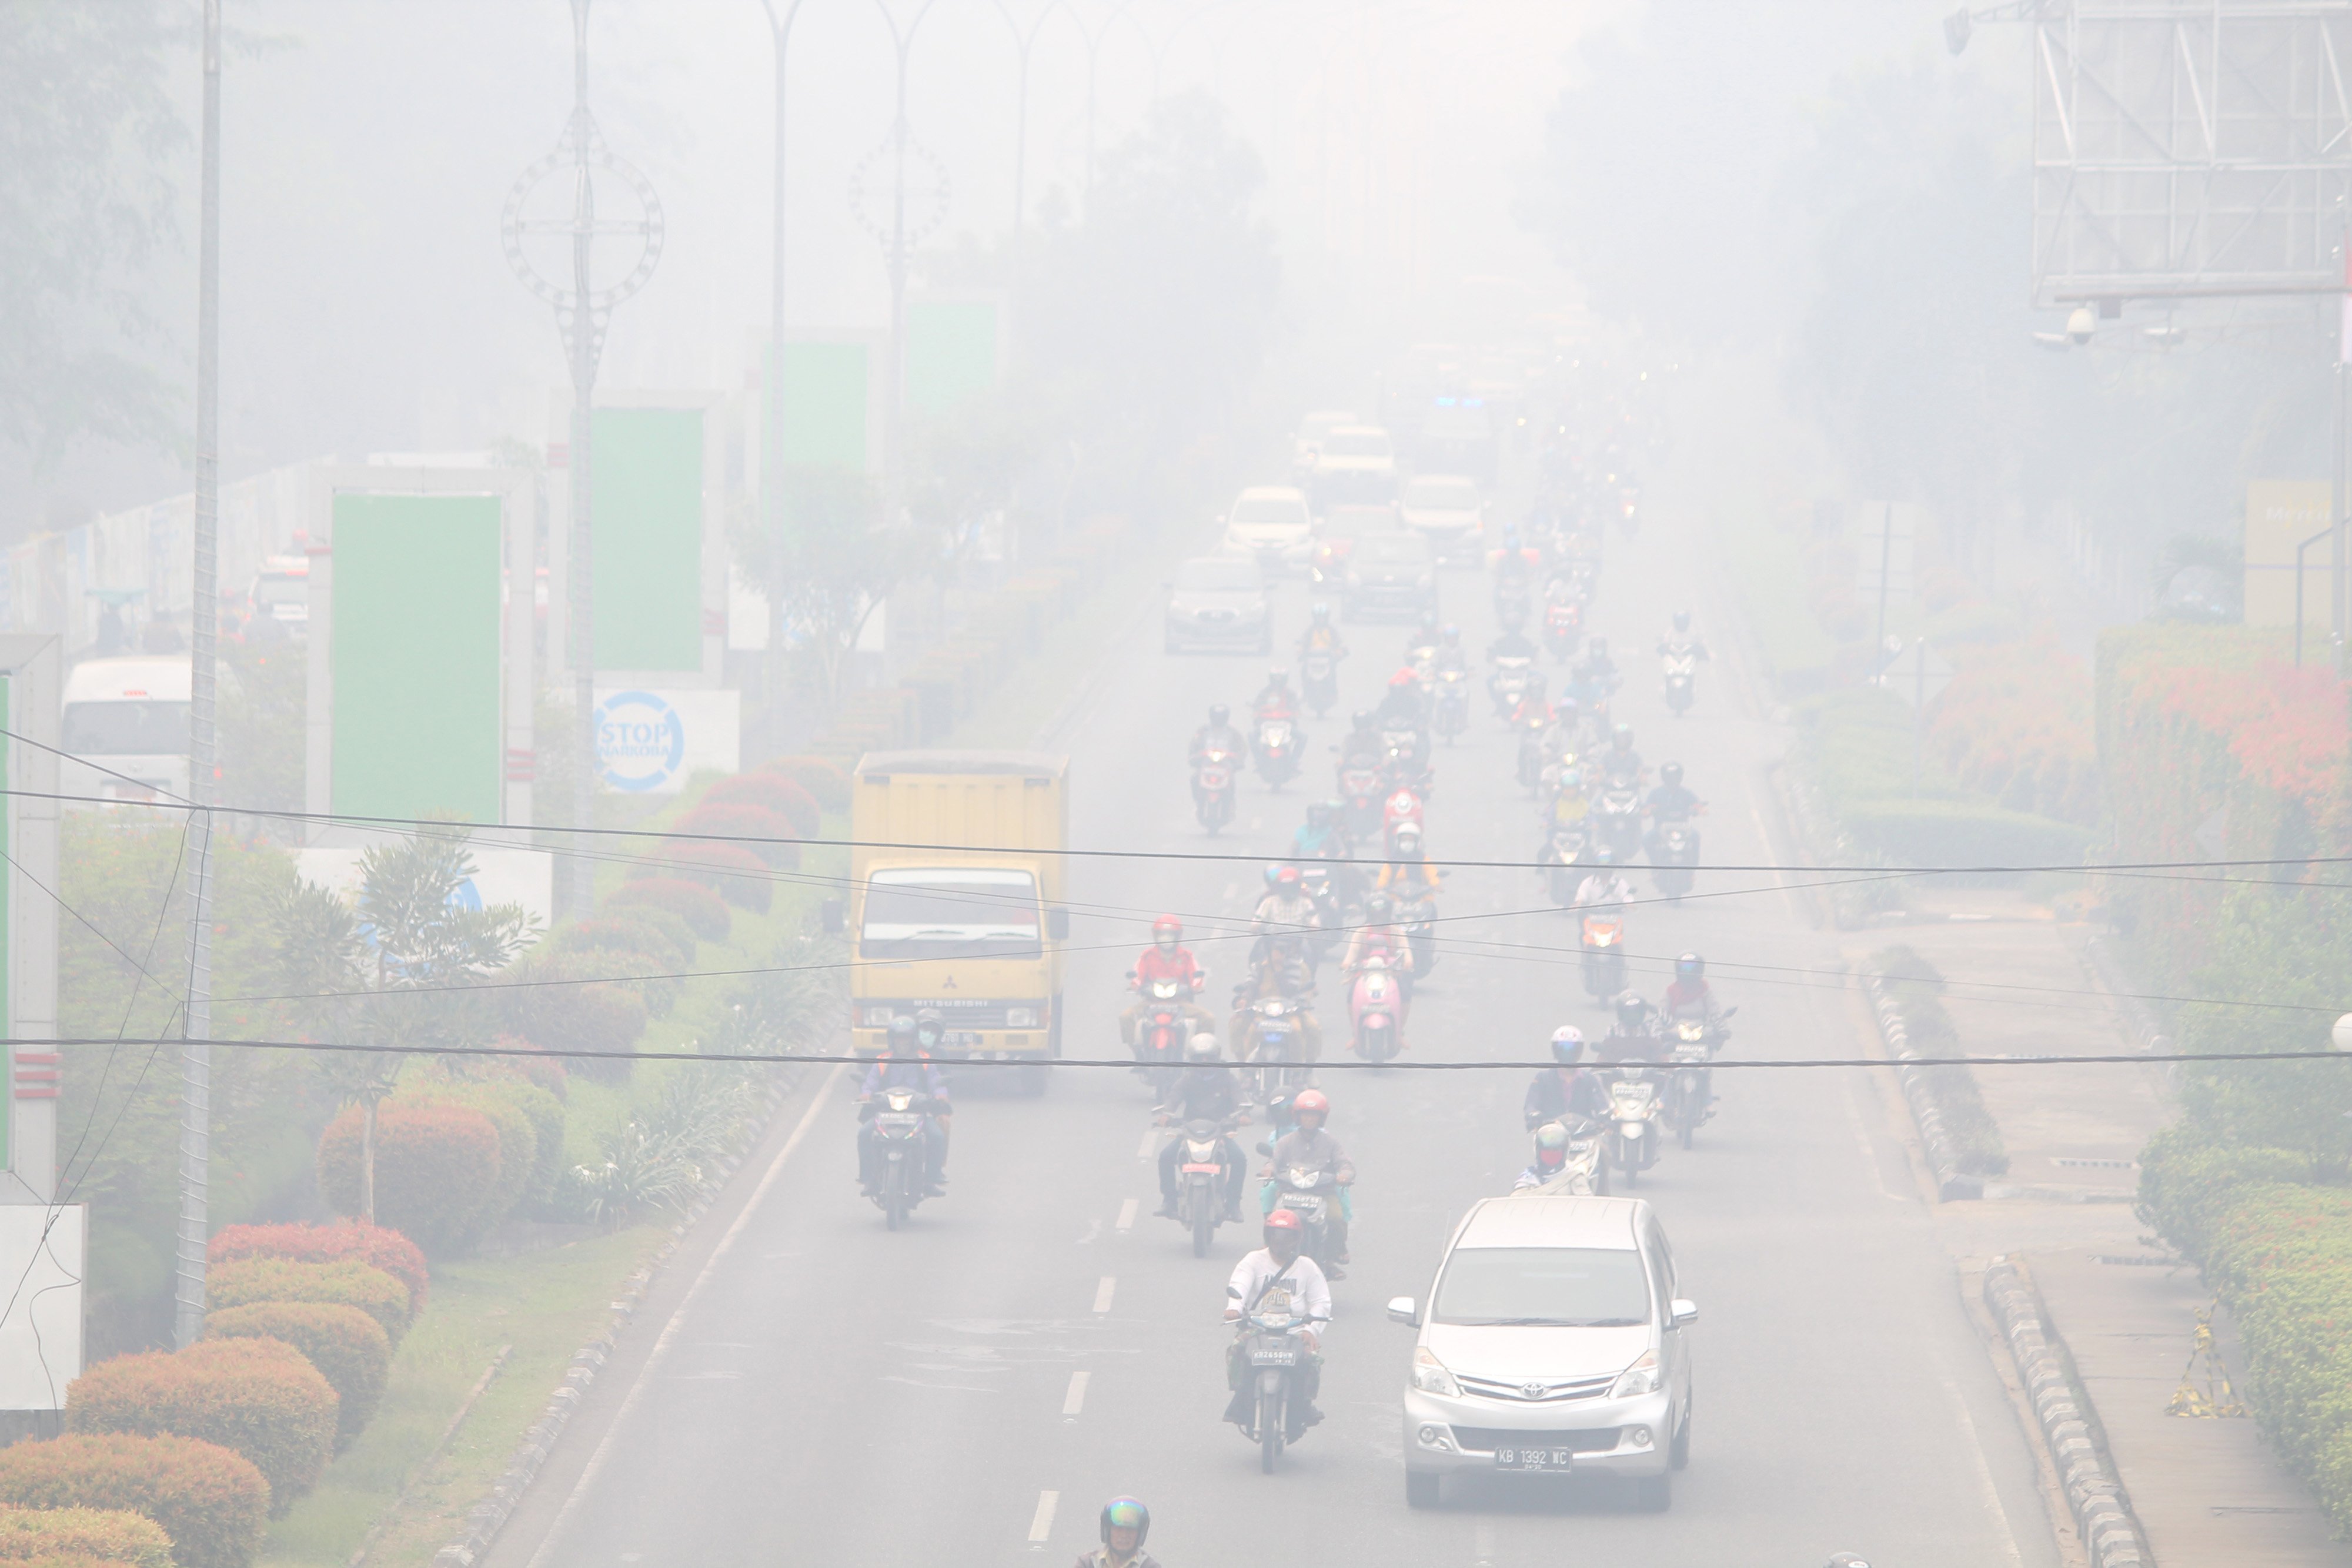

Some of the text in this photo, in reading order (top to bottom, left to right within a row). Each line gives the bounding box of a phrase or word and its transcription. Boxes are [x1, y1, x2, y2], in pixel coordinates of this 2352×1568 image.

[601, 723, 669, 744] STOP
[597, 745, 669, 757] NARKOBA
[1499, 1450, 1566, 1465] KB 1392 WC
